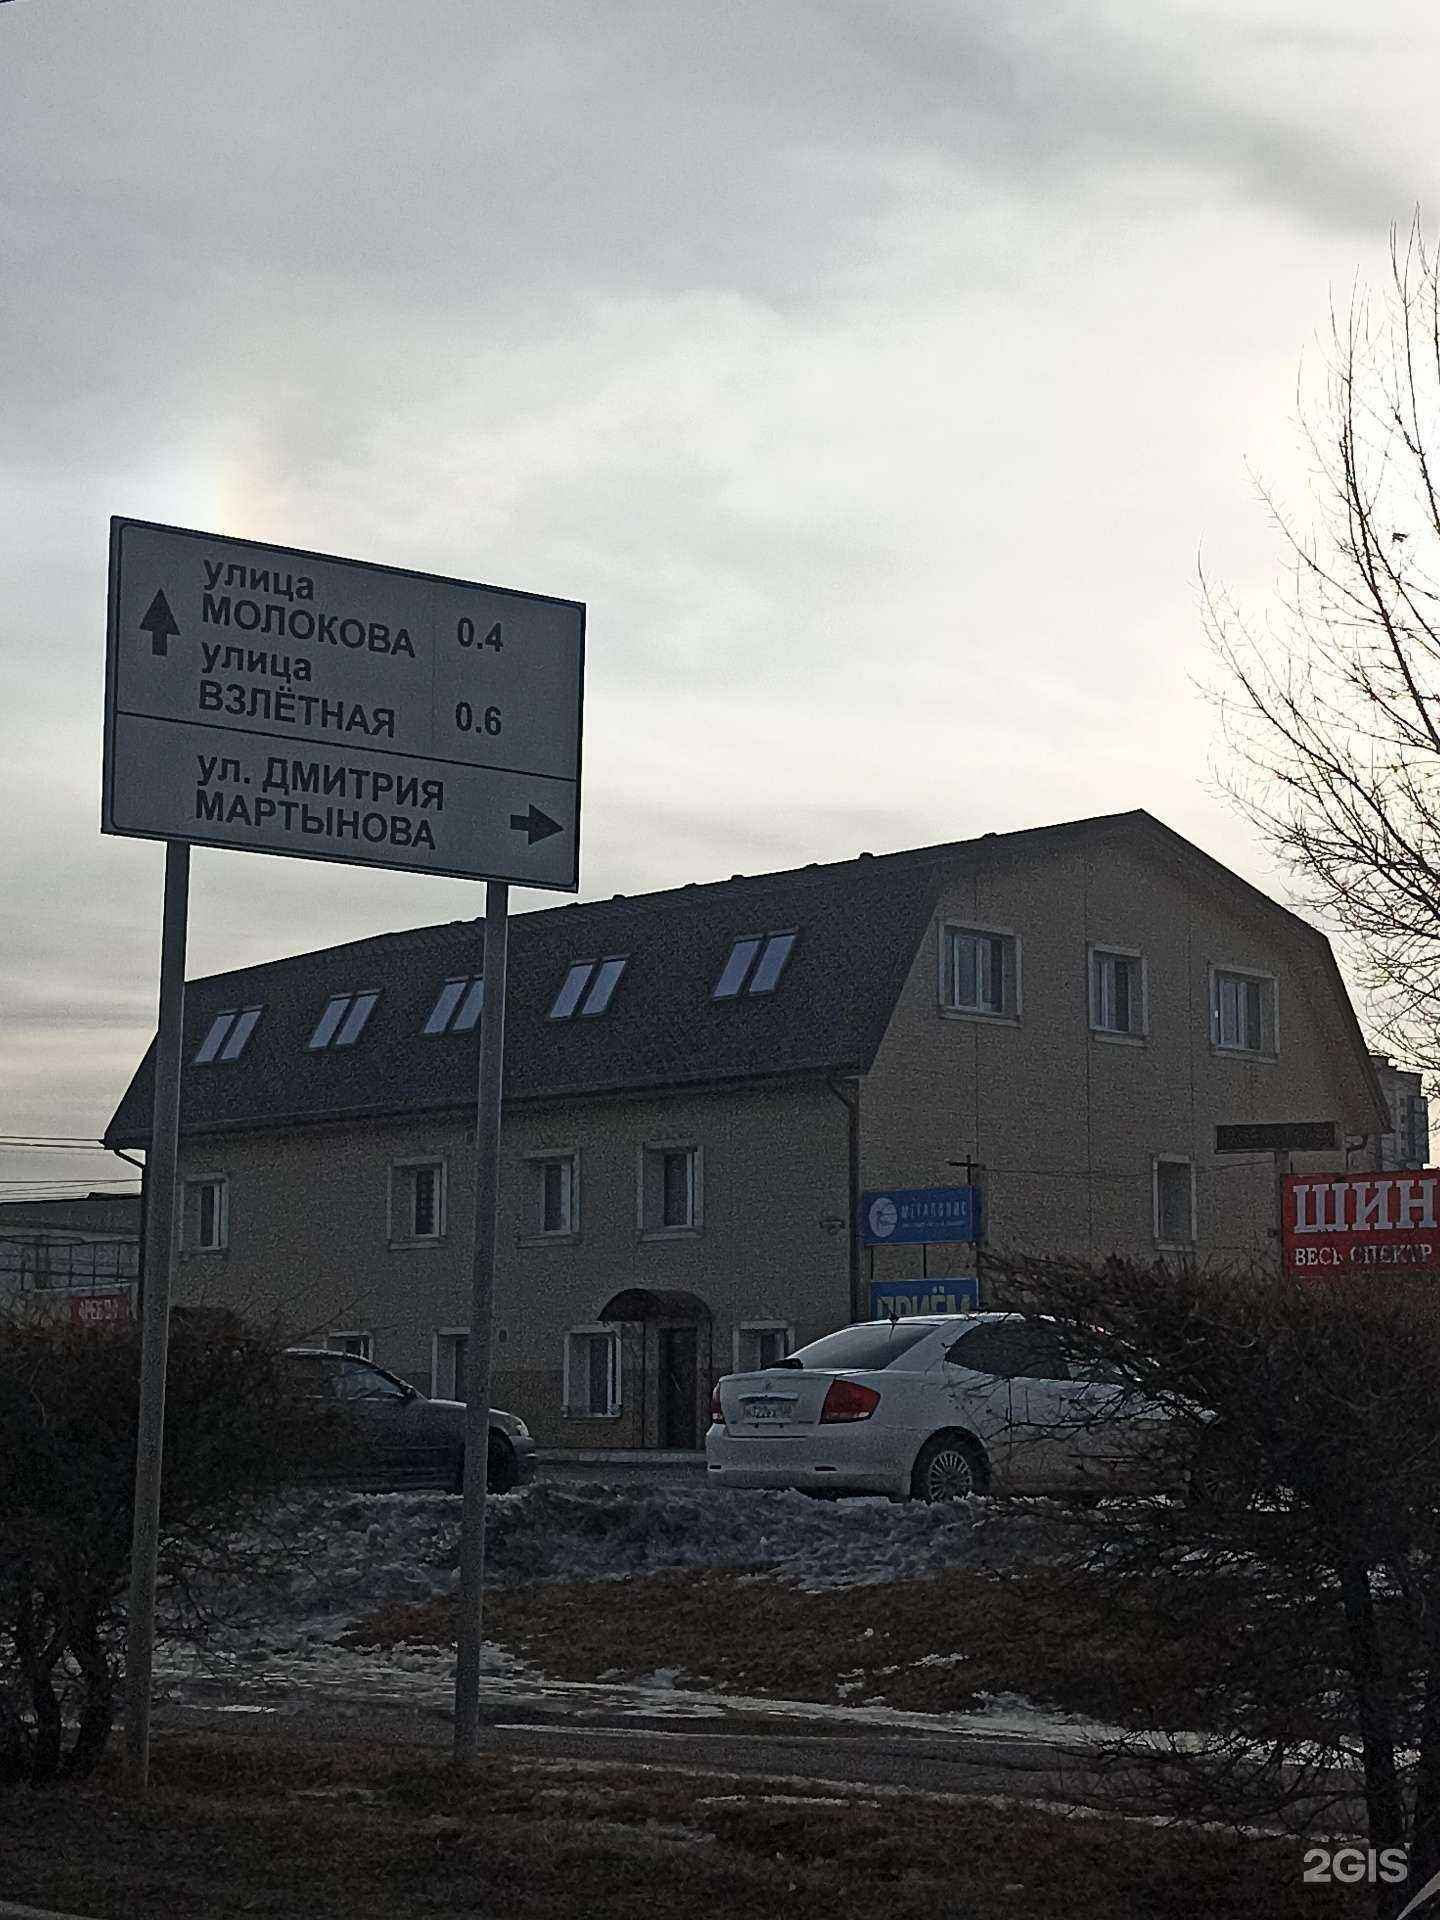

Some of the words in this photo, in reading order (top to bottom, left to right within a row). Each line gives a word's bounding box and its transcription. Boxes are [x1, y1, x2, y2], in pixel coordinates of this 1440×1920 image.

[203, 558, 315, 601] улица
[201, 594, 416, 658] МОЛОКОВА
[456, 616, 504, 652] 0.4
[200, 642, 312, 682] улица
[199, 679, 396, 738] ВЗЛЁТНАЯ
[455, 701, 501, 736] 0.6
[196, 754, 251, 787] ул.
[262, 757, 444, 811] ДМИТРИЯ
[195, 789, 437, 851] МАРТЫНОВА
[1295, 1246, 1343, 1266] ВЕСЬ
